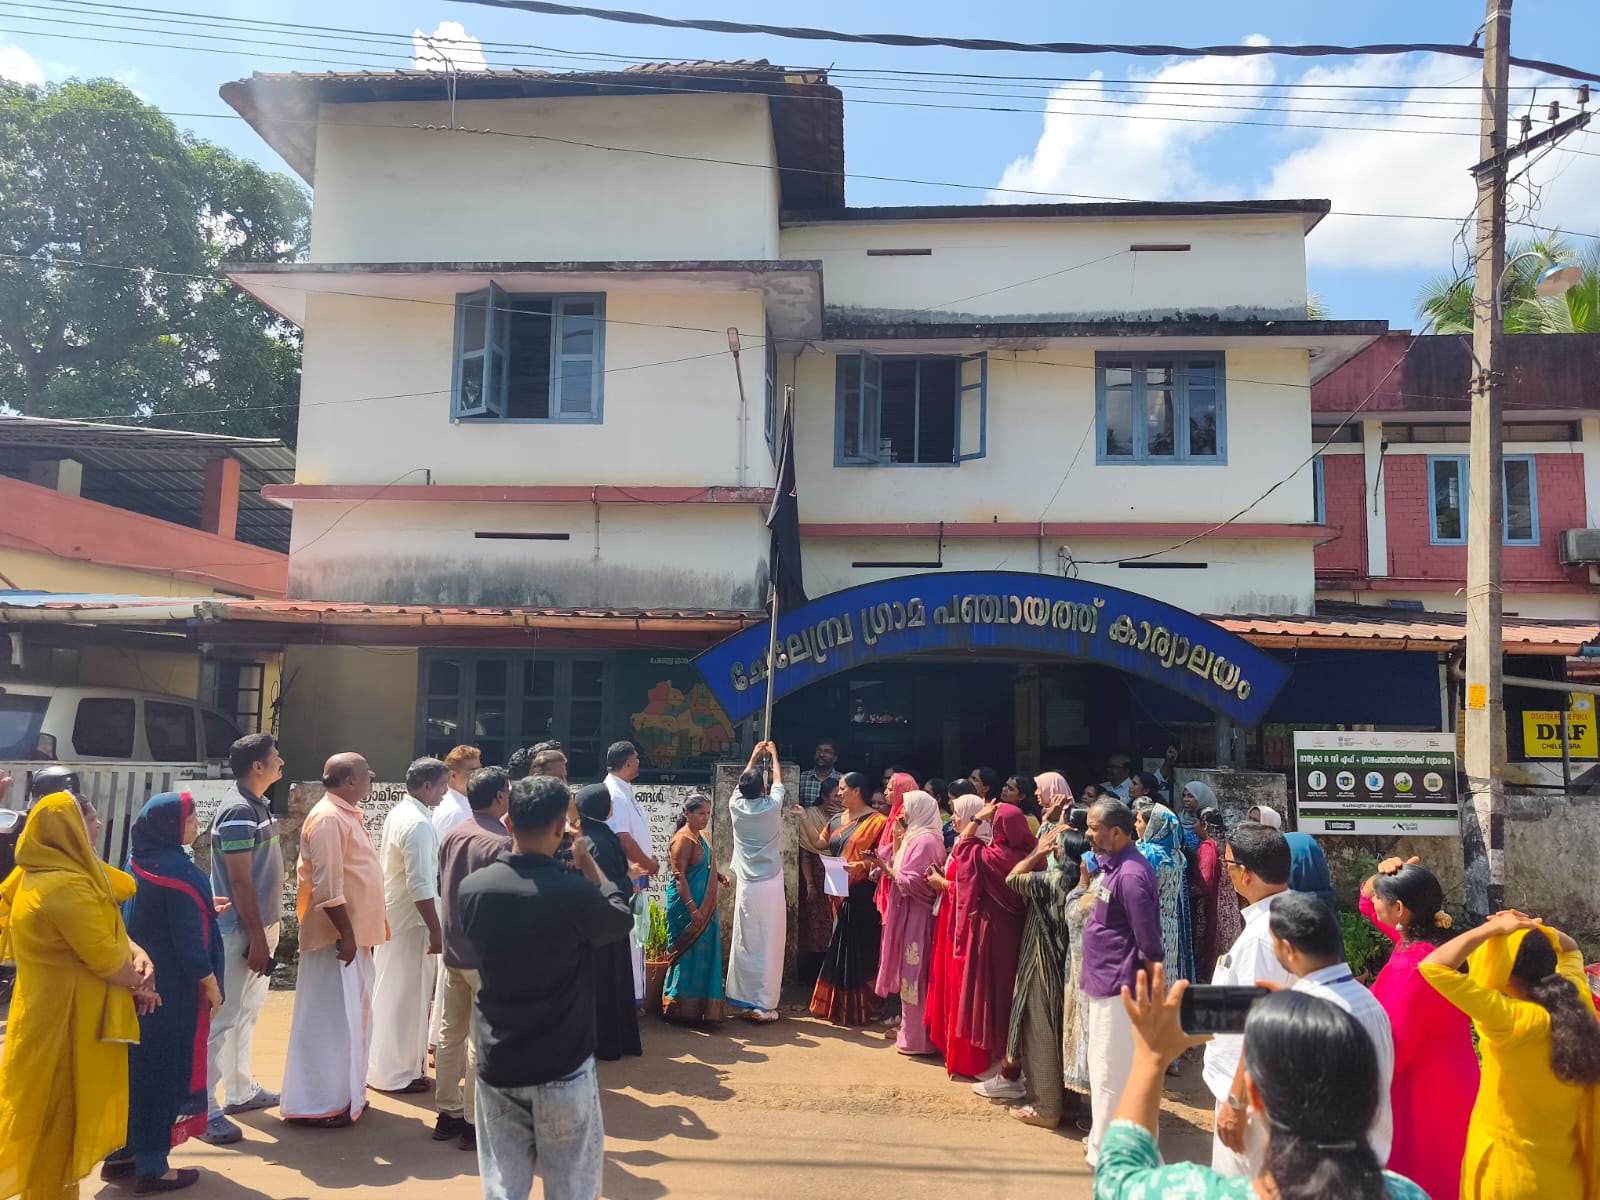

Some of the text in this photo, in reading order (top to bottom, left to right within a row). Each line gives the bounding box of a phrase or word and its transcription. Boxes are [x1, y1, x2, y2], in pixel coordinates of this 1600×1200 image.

[860, 597, 926, 645] ഗ്രാമ
[934, 594, 1105, 634] പഞ്ചായത്ത്
[1108, 614, 1251, 701] കാര്യാലയം
